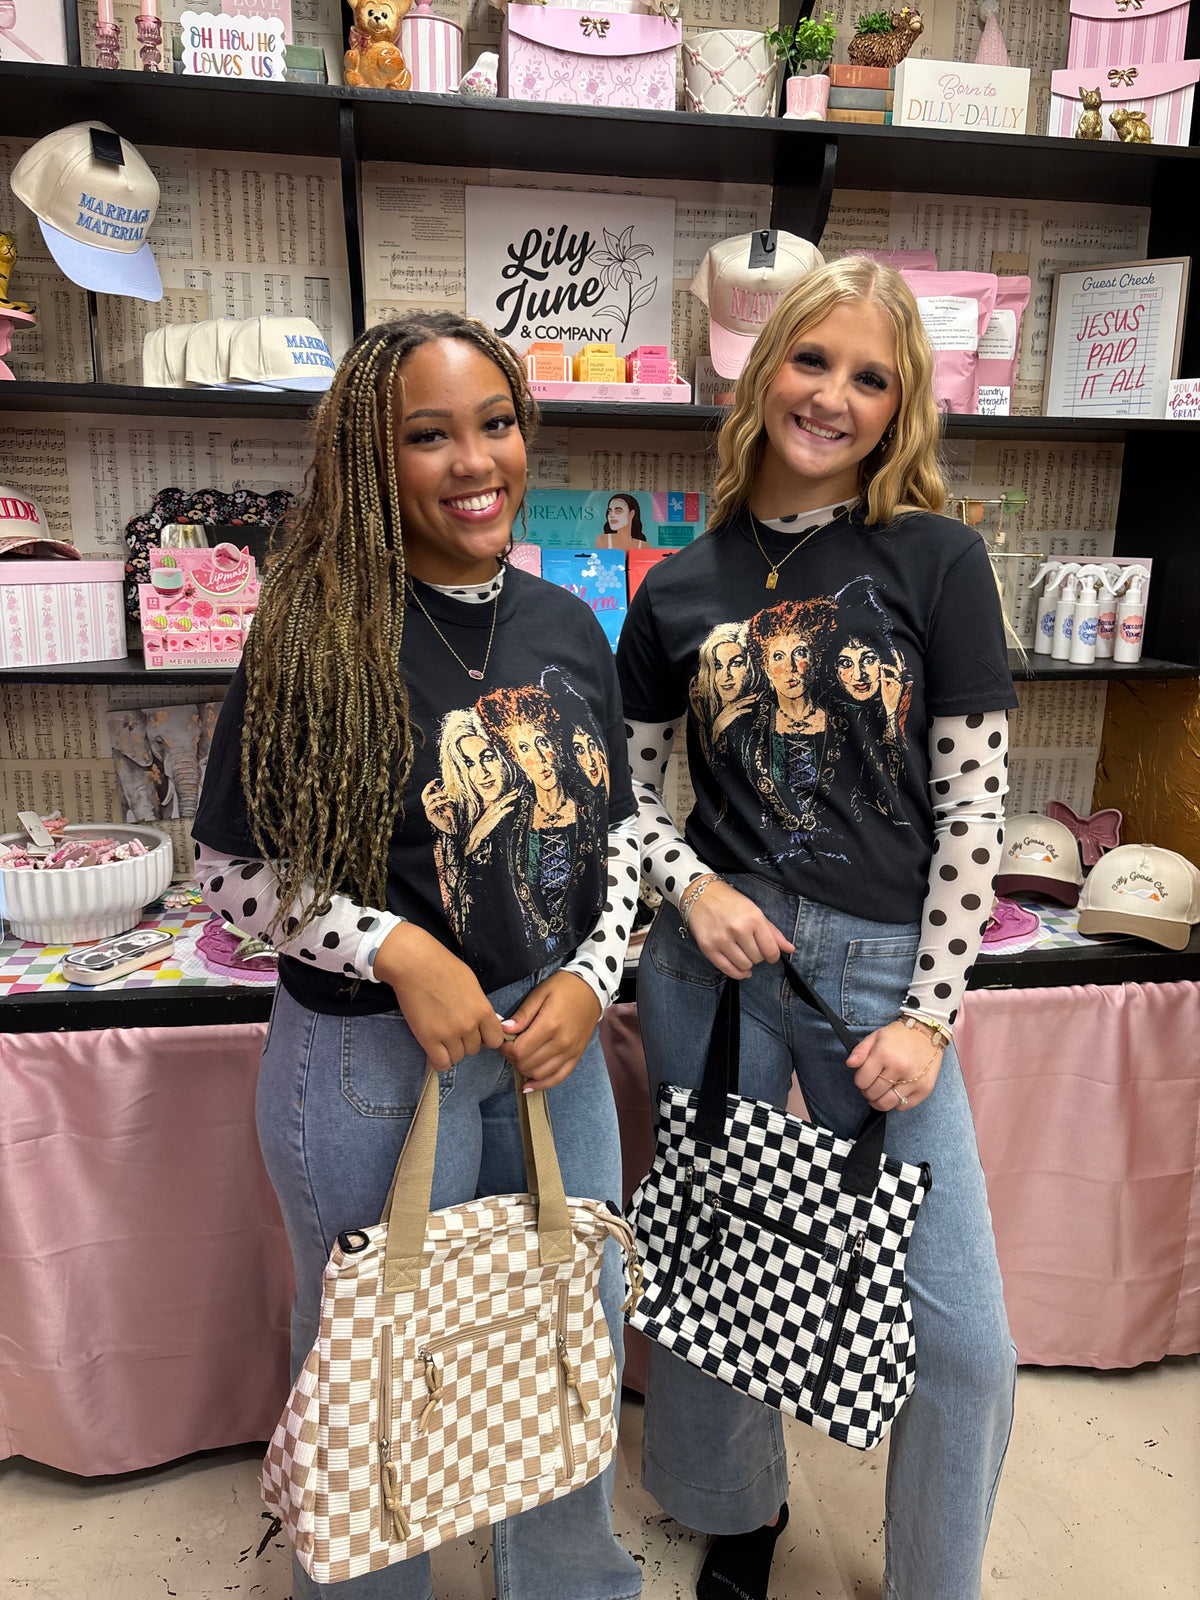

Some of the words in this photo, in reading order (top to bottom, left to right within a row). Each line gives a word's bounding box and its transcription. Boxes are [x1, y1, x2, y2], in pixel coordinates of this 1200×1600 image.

[190, 26, 213, 49] OH
[219, 28, 254, 51] HOW
[252, 56, 273, 78] US
[938, 74, 981, 100] Born
[983, 83, 998, 97] to
[907, 99, 1024, 129] DILLY-DALLY
[78, 192, 151, 224] MARRIAGE
[76, 212, 145, 241] MATERIAL
[501, 224, 597, 282] Lily
[1082, 276, 1117, 292] Guest
[1119, 272, 1156, 289] Check
[494, 278, 605, 338] June
[730, 286, 783, 325] MA
[520, 325, 532, 339] &
[535, 325, 613, 342] COMPANY
[1077, 304, 1146, 342] JESUS
[1087, 337, 1138, 371] PAID
[978, 387, 1004, 399] aundry
[1081, 373, 1105, 400] IT
[1109, 364, 1146, 395] ALL
[1169, 392, 1200, 411] doin
[1173, 408, 1197, 419] GREAT
[0, 497, 40, 524] IDE
